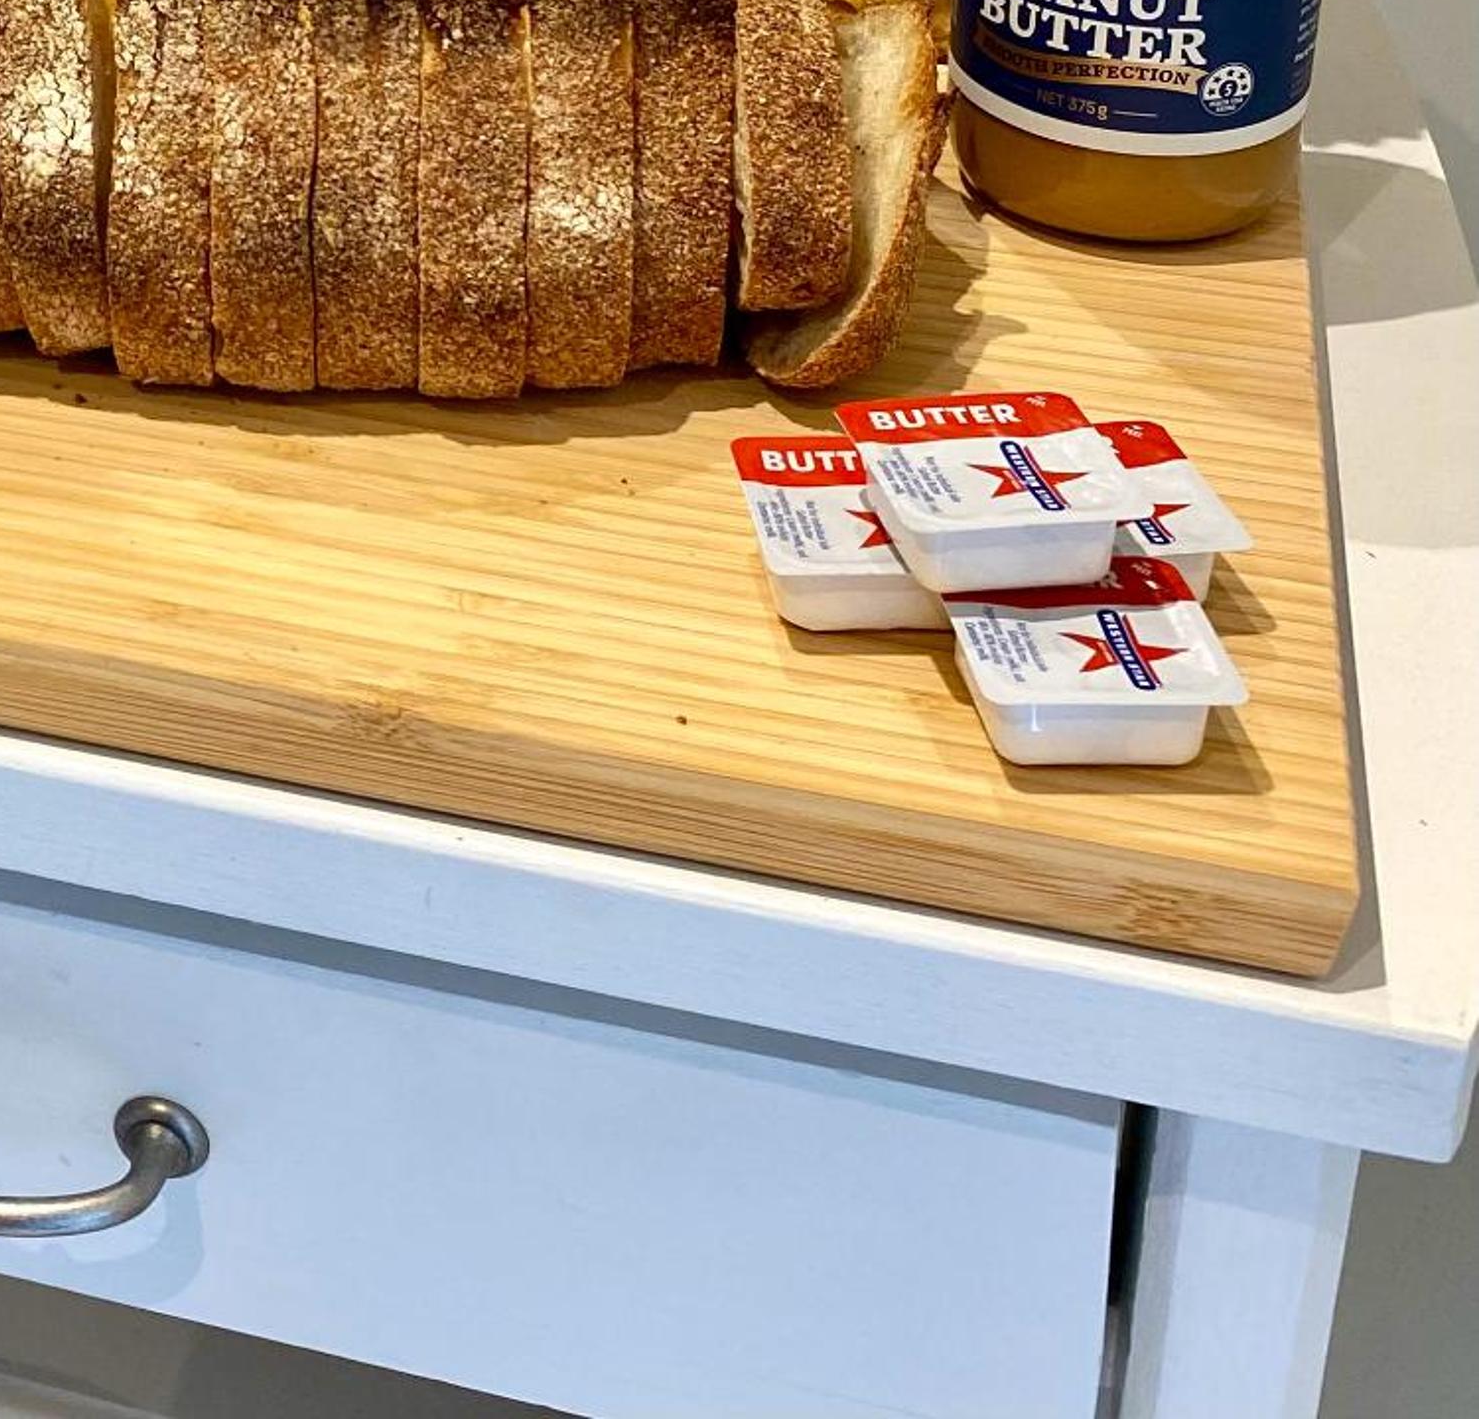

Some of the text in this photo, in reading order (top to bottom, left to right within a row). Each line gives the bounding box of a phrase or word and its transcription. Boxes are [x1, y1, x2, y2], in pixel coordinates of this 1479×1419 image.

[1053, 60, 1192, 86] PERFECTION
[1035, 87, 1065, 108] NET
[867, 402, 1023, 431] BUTTER
